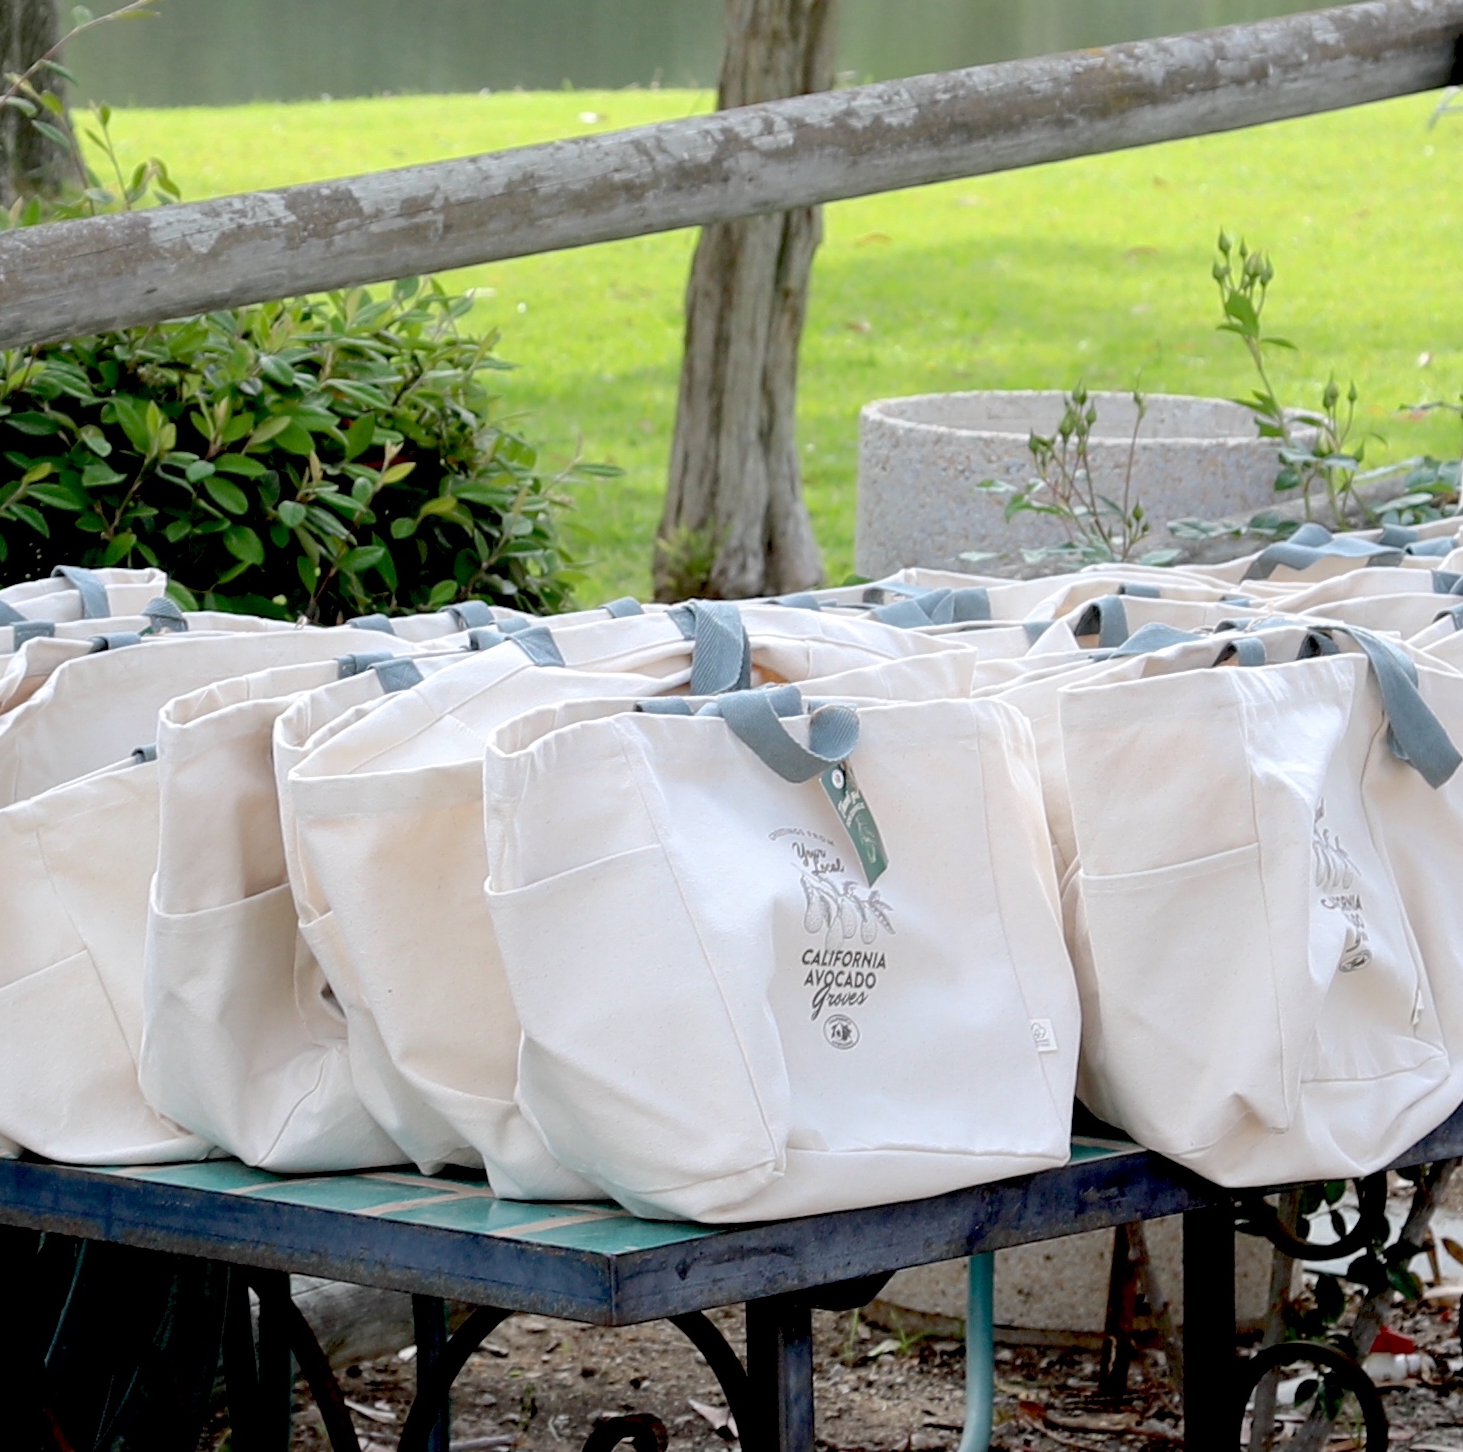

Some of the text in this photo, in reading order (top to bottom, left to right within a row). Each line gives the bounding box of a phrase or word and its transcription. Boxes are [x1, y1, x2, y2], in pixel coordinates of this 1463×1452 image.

[791, 841, 827, 867] Your
[801, 948, 887, 969] CALIFORNIA
[803, 969, 877, 989] AVOCADO
[810, 982, 869, 1022] Groves
